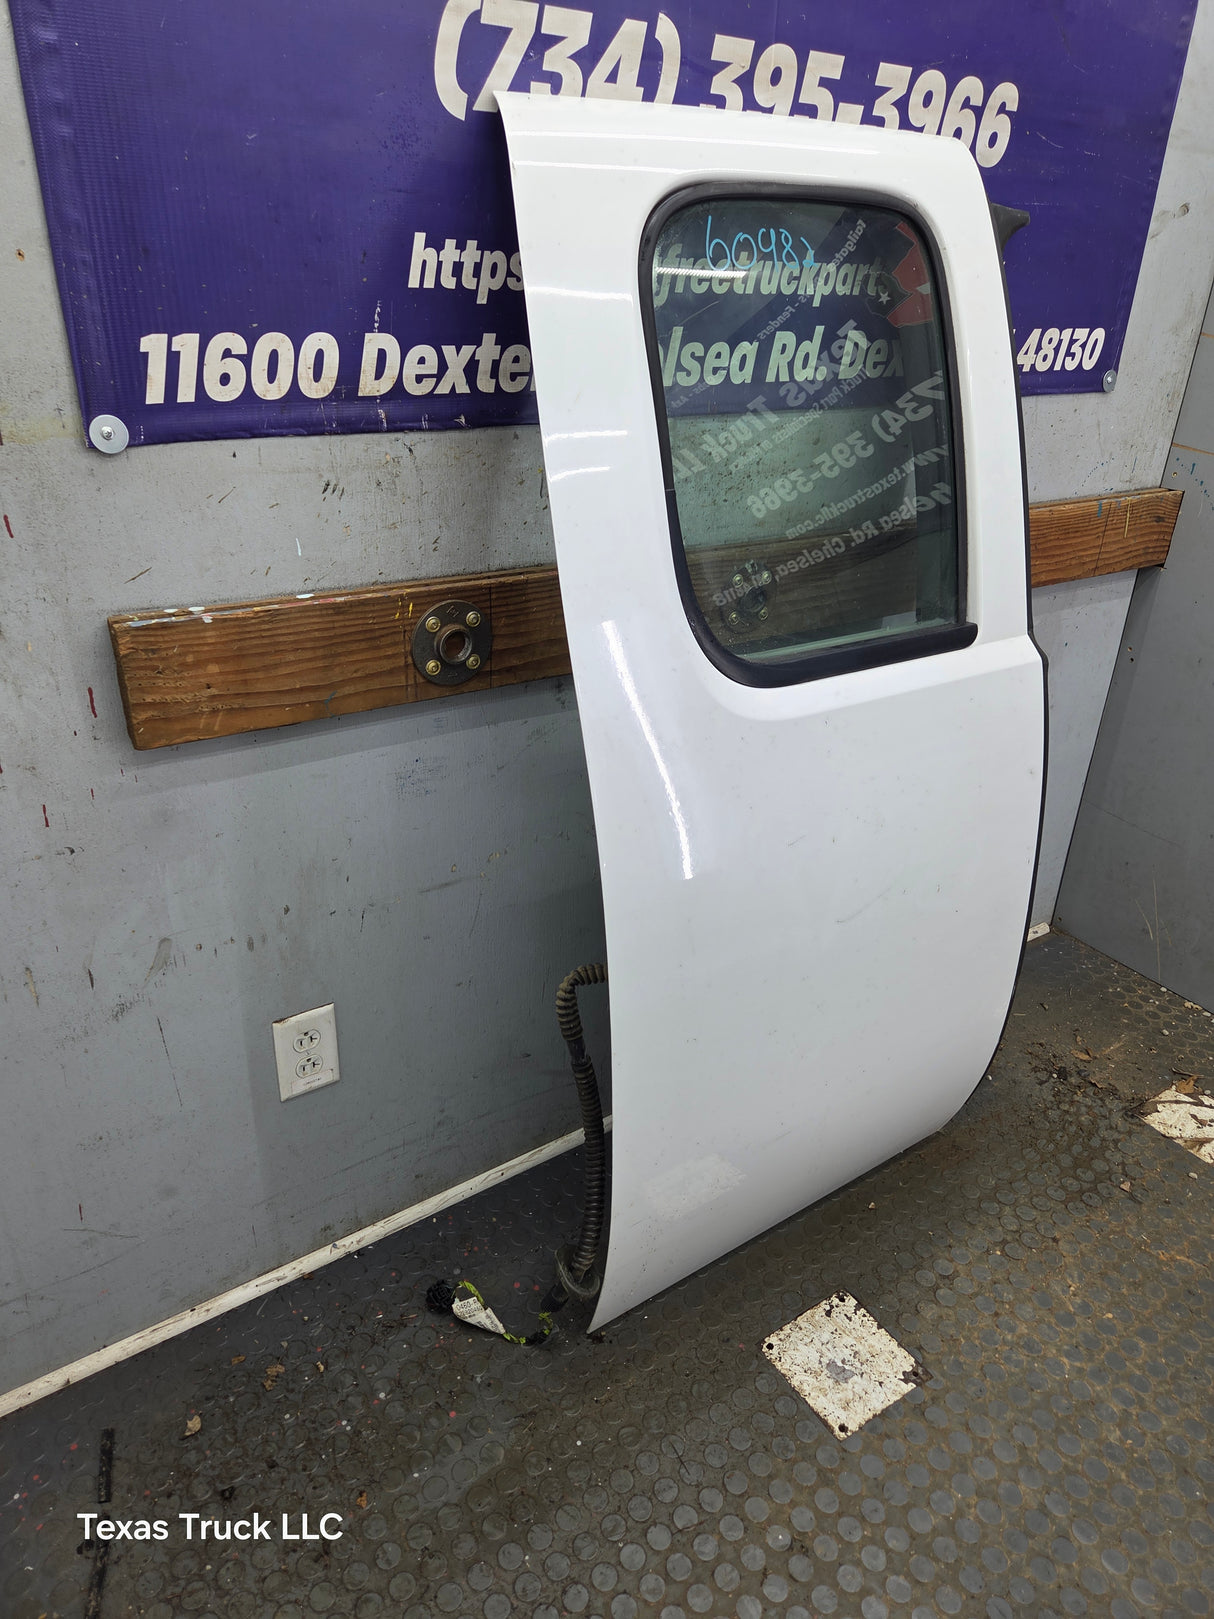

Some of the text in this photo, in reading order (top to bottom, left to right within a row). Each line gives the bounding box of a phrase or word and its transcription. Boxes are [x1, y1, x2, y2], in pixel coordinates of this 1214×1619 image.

[434, 0, 1018, 168] (734) 395-3966
[140, 332, 339, 405] 11600
[358, 332, 535, 397] Dexte
[658, 326, 759, 386] lsea
[766, 325, 826, 384] Rd.
[1017, 328, 1105, 372] 48130
